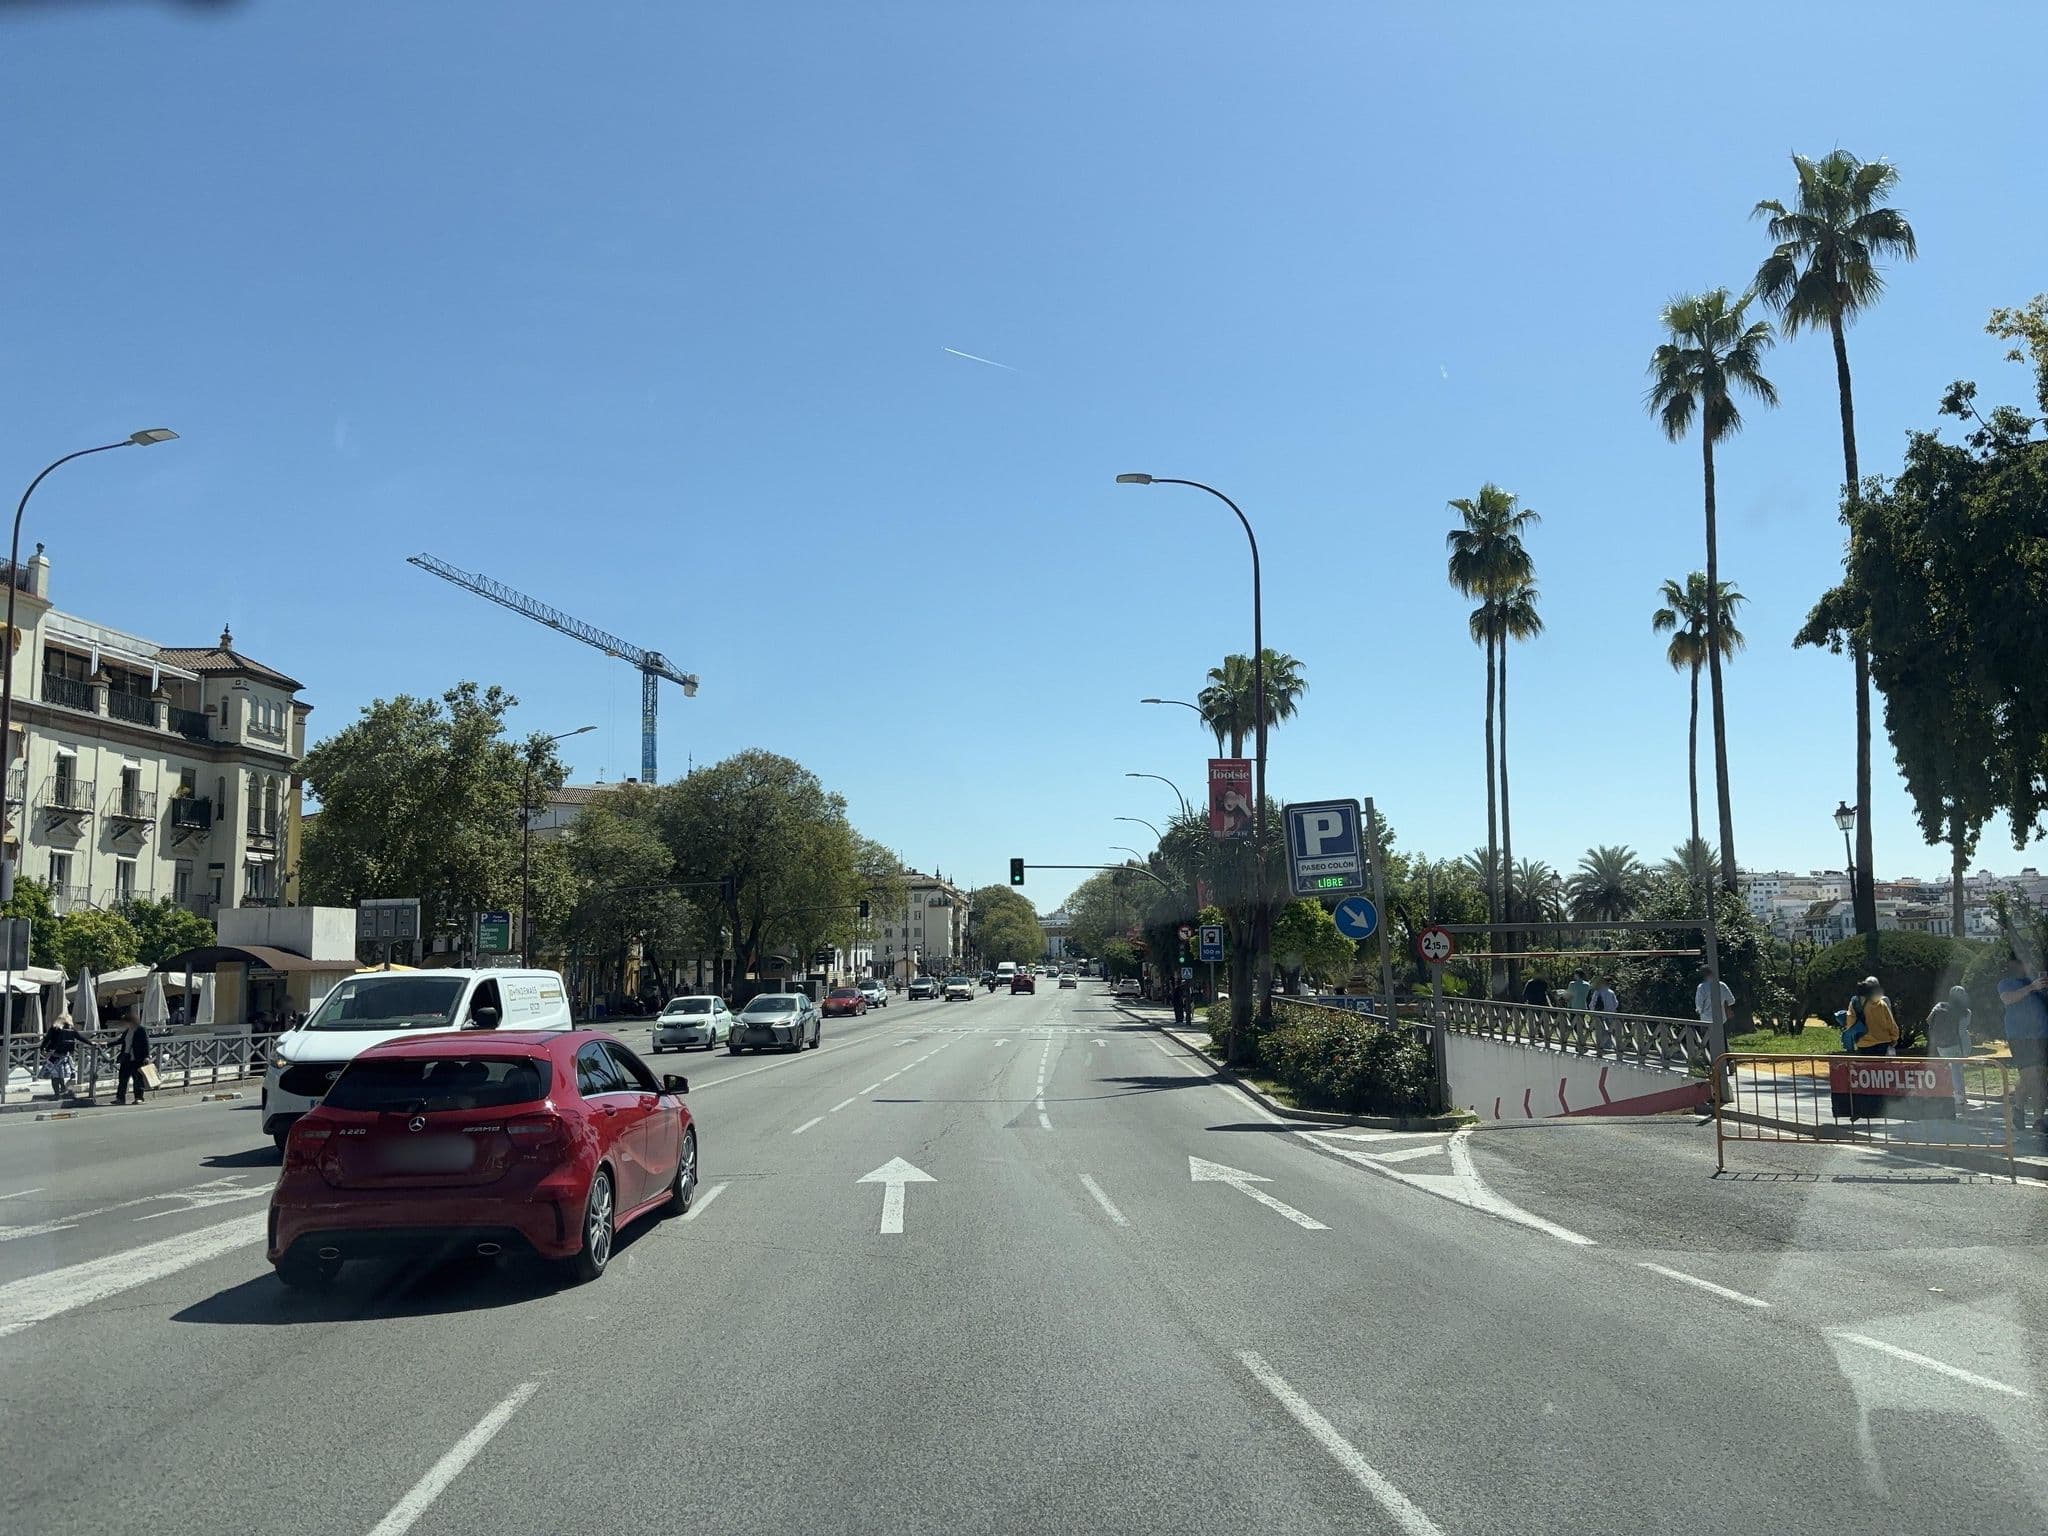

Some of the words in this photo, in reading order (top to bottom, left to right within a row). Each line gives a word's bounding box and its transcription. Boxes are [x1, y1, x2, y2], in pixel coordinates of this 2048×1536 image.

[1210, 768, 1249, 780] Tootsie
[1303, 811, 1343, 855] P
[1302, 863, 1327, 871] PASEO
[1327, 860, 1354, 870] COLÓN
[1317, 877, 1344, 888] LIBRE
[481, 913, 489, 923] P
[1423, 937, 1442, 951] 2,15
[1850, 1069, 1937, 1089] COMPLETO
